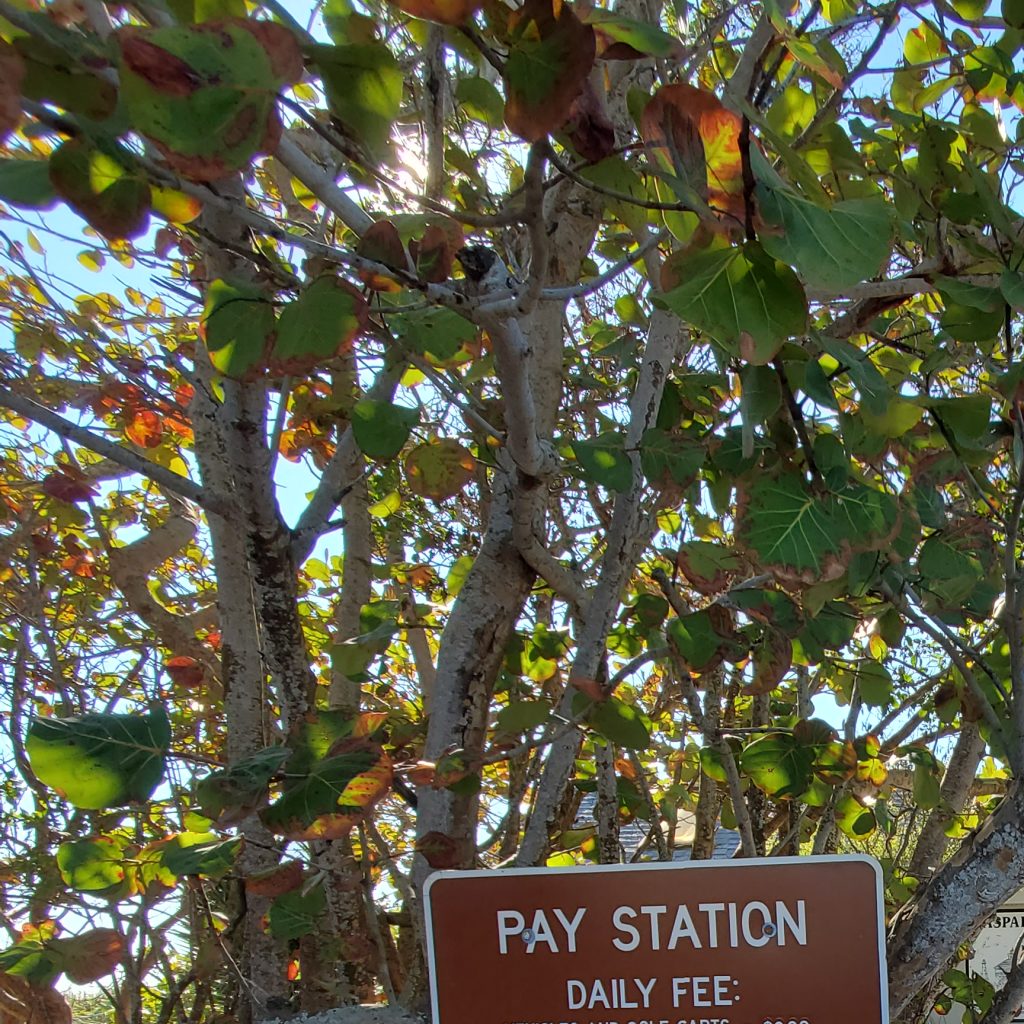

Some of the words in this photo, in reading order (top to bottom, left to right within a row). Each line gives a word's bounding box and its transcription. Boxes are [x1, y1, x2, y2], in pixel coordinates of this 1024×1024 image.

[498, 908, 586, 953] PAY
[613, 900, 806, 951] STATION
[568, 979, 656, 1009] DAILY
[673, 976, 739, 1007] FEE:
